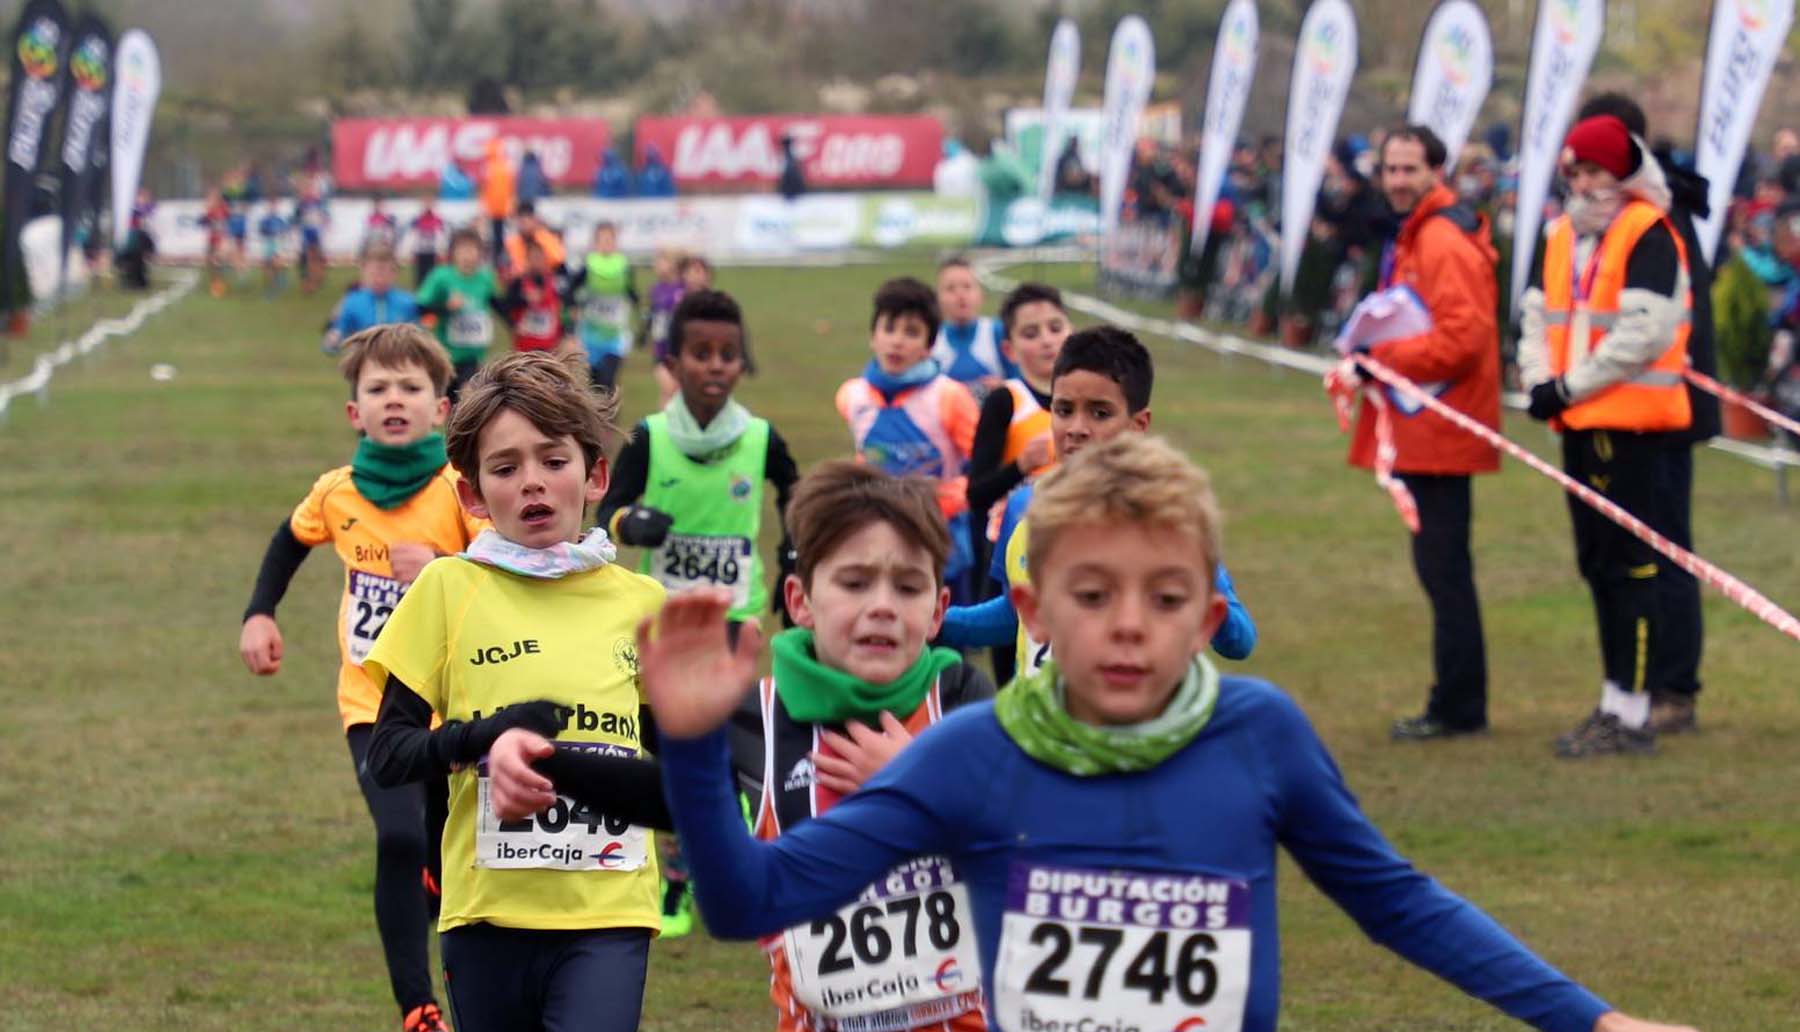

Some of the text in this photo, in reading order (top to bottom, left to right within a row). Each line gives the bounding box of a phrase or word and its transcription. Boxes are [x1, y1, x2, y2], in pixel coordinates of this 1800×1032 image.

[664, 546, 739, 586] 2649
[497, 842, 583, 864] iberCaja
[1028, 869, 1229, 903] DIPUTACIÓN
[1025, 893, 1228, 929] BURGOS
[810, 890, 961, 978] 2678
[1023, 922, 1220, 1008] 2746
[821, 972, 920, 1009] iberCaja
